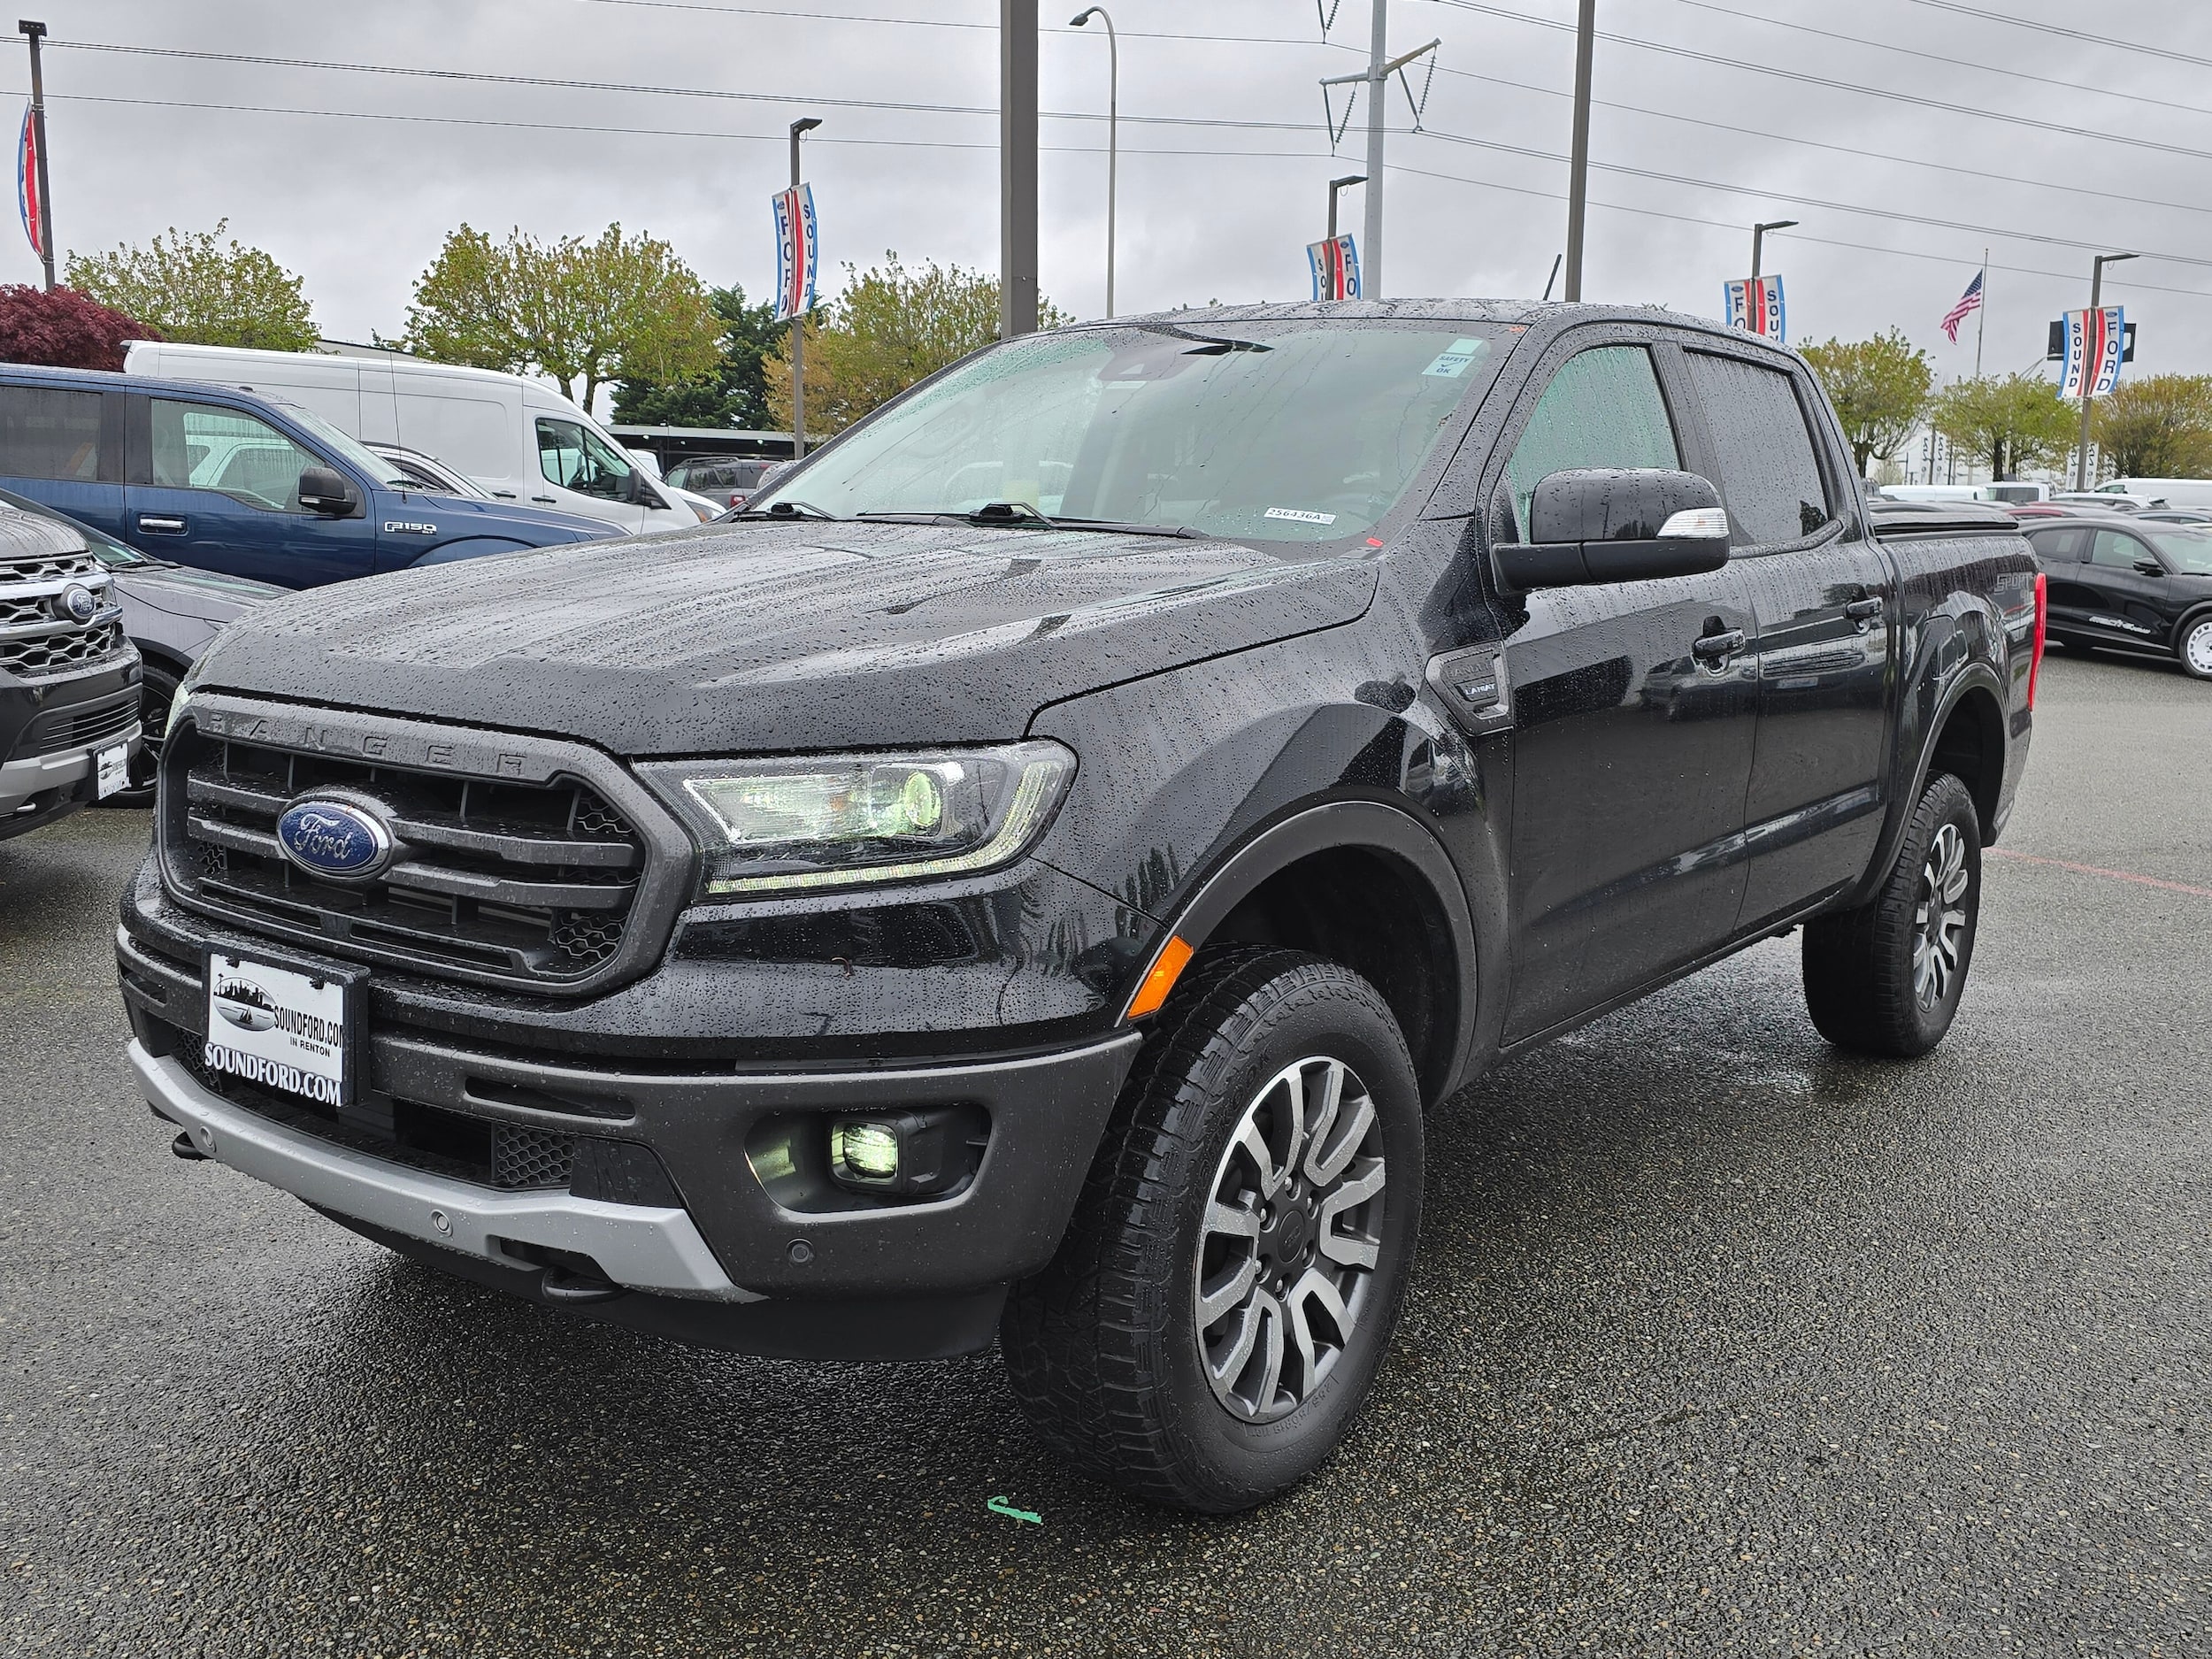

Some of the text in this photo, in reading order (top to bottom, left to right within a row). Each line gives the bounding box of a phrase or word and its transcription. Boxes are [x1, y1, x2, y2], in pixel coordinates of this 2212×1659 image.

[803, 204, 815, 298] SOUND
[2068, 322, 2082, 388] SOUND
[2096, 321, 2118, 391] FORD
[1267, 509, 1321, 520] 256436A
[1993, 571, 2033, 595] SPORT
[210, 711, 527, 778] RANGER
[294, 813, 354, 860] Ford
[204, 1041, 342, 1107] SOUNDFORD.COM
[290, 1036, 331, 1058] IN RENTON
